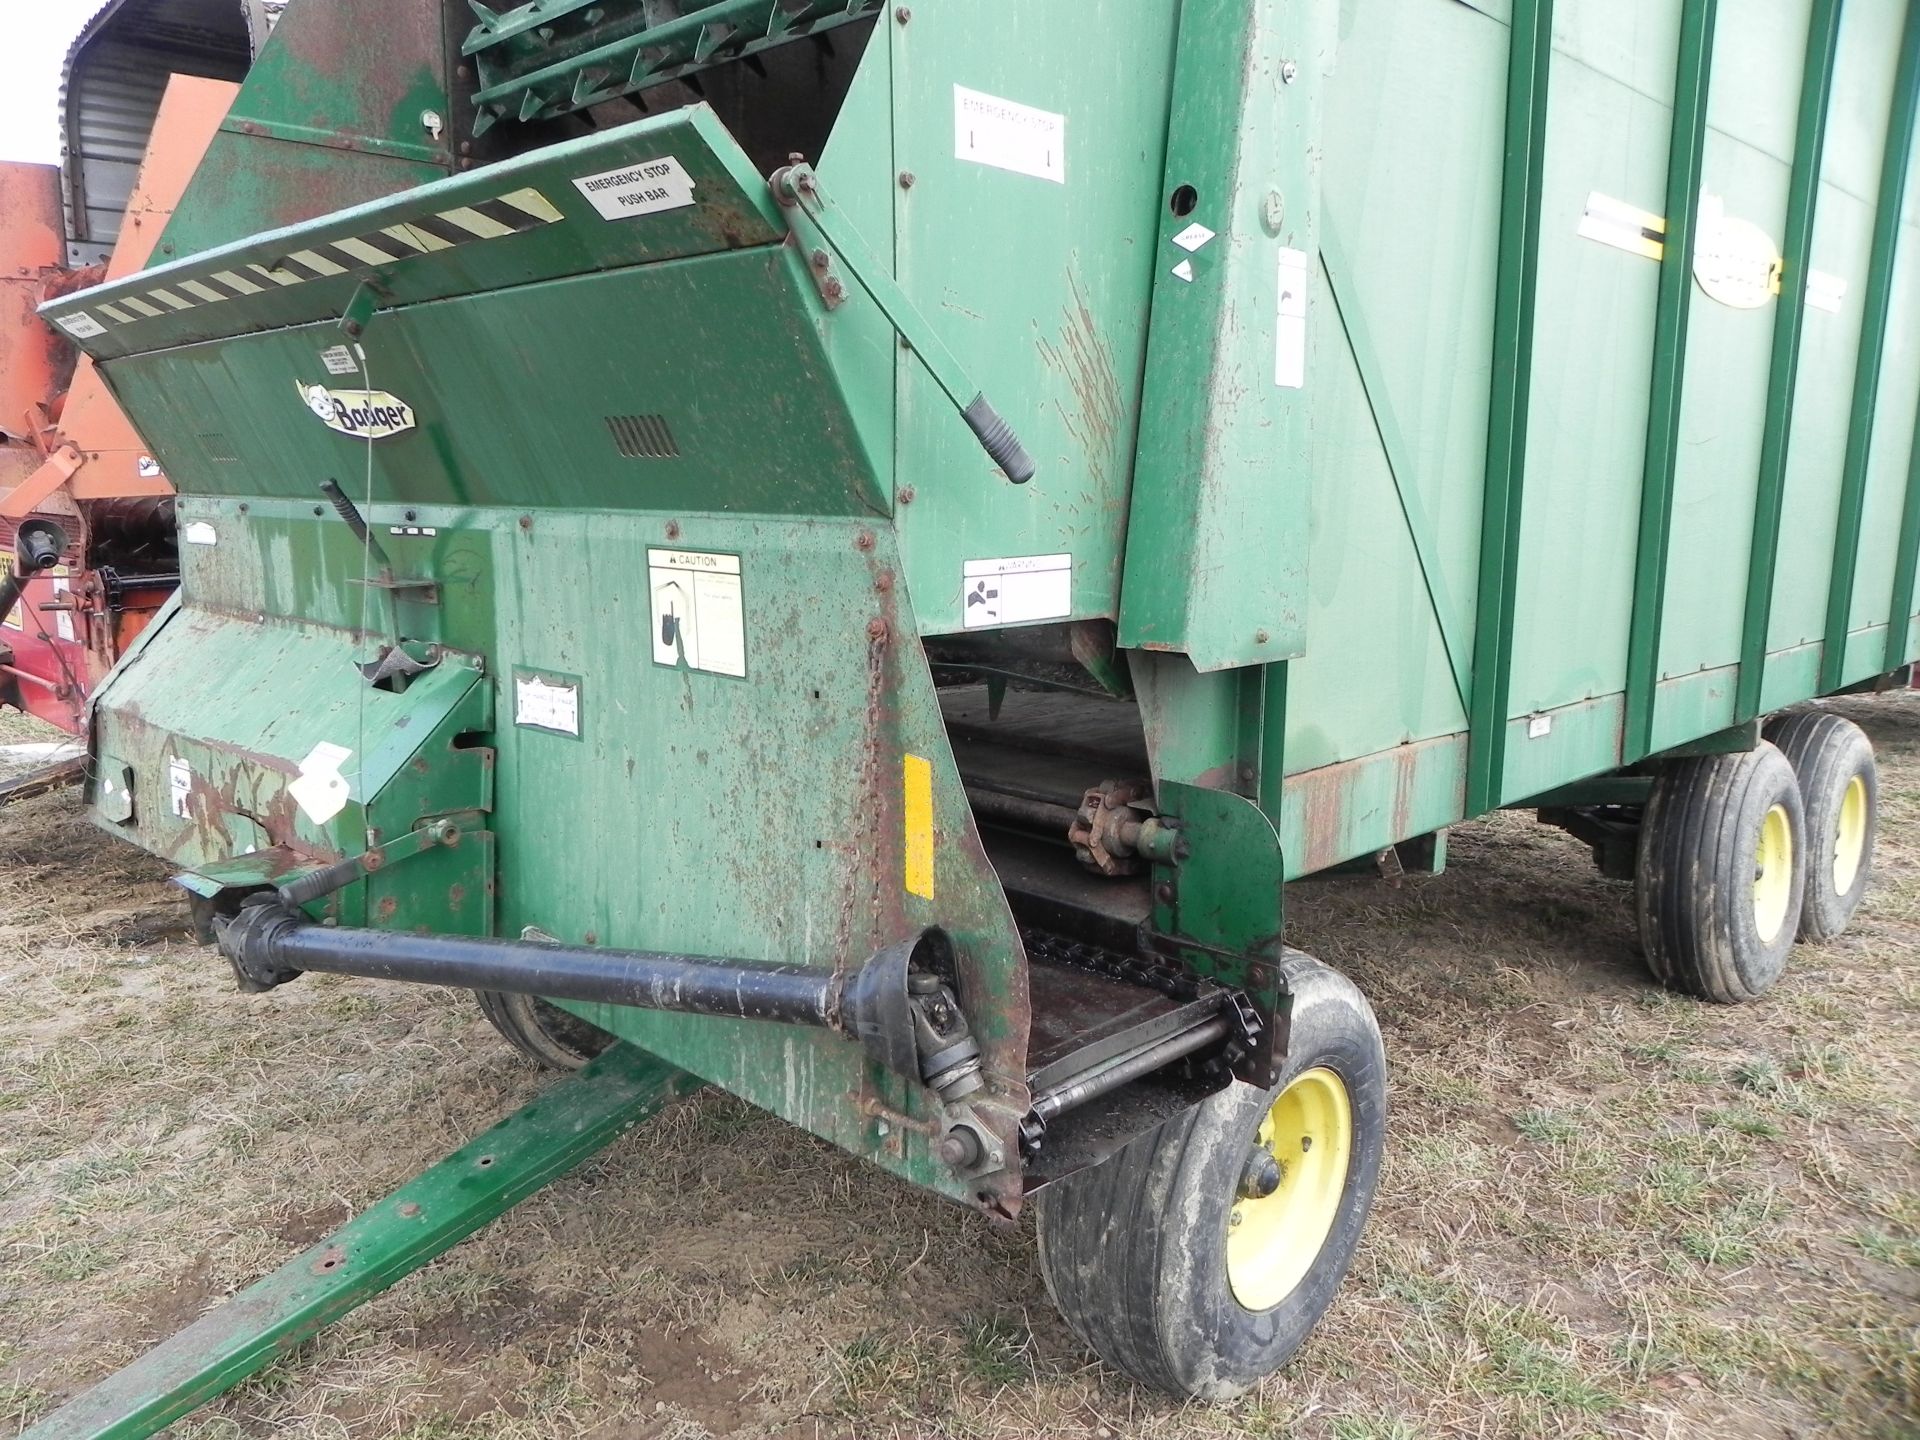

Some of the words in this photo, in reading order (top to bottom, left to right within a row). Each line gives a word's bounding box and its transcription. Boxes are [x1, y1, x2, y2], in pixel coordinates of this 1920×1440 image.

[584, 170, 646, 193] EMERGENCY
[643, 162, 671, 179] STOP
[617, 192, 647, 208] PUSH
[645, 187, 670, 202] BAR
[333, 397, 408, 432] Badger
[678, 554, 718, 567] CAUTION
